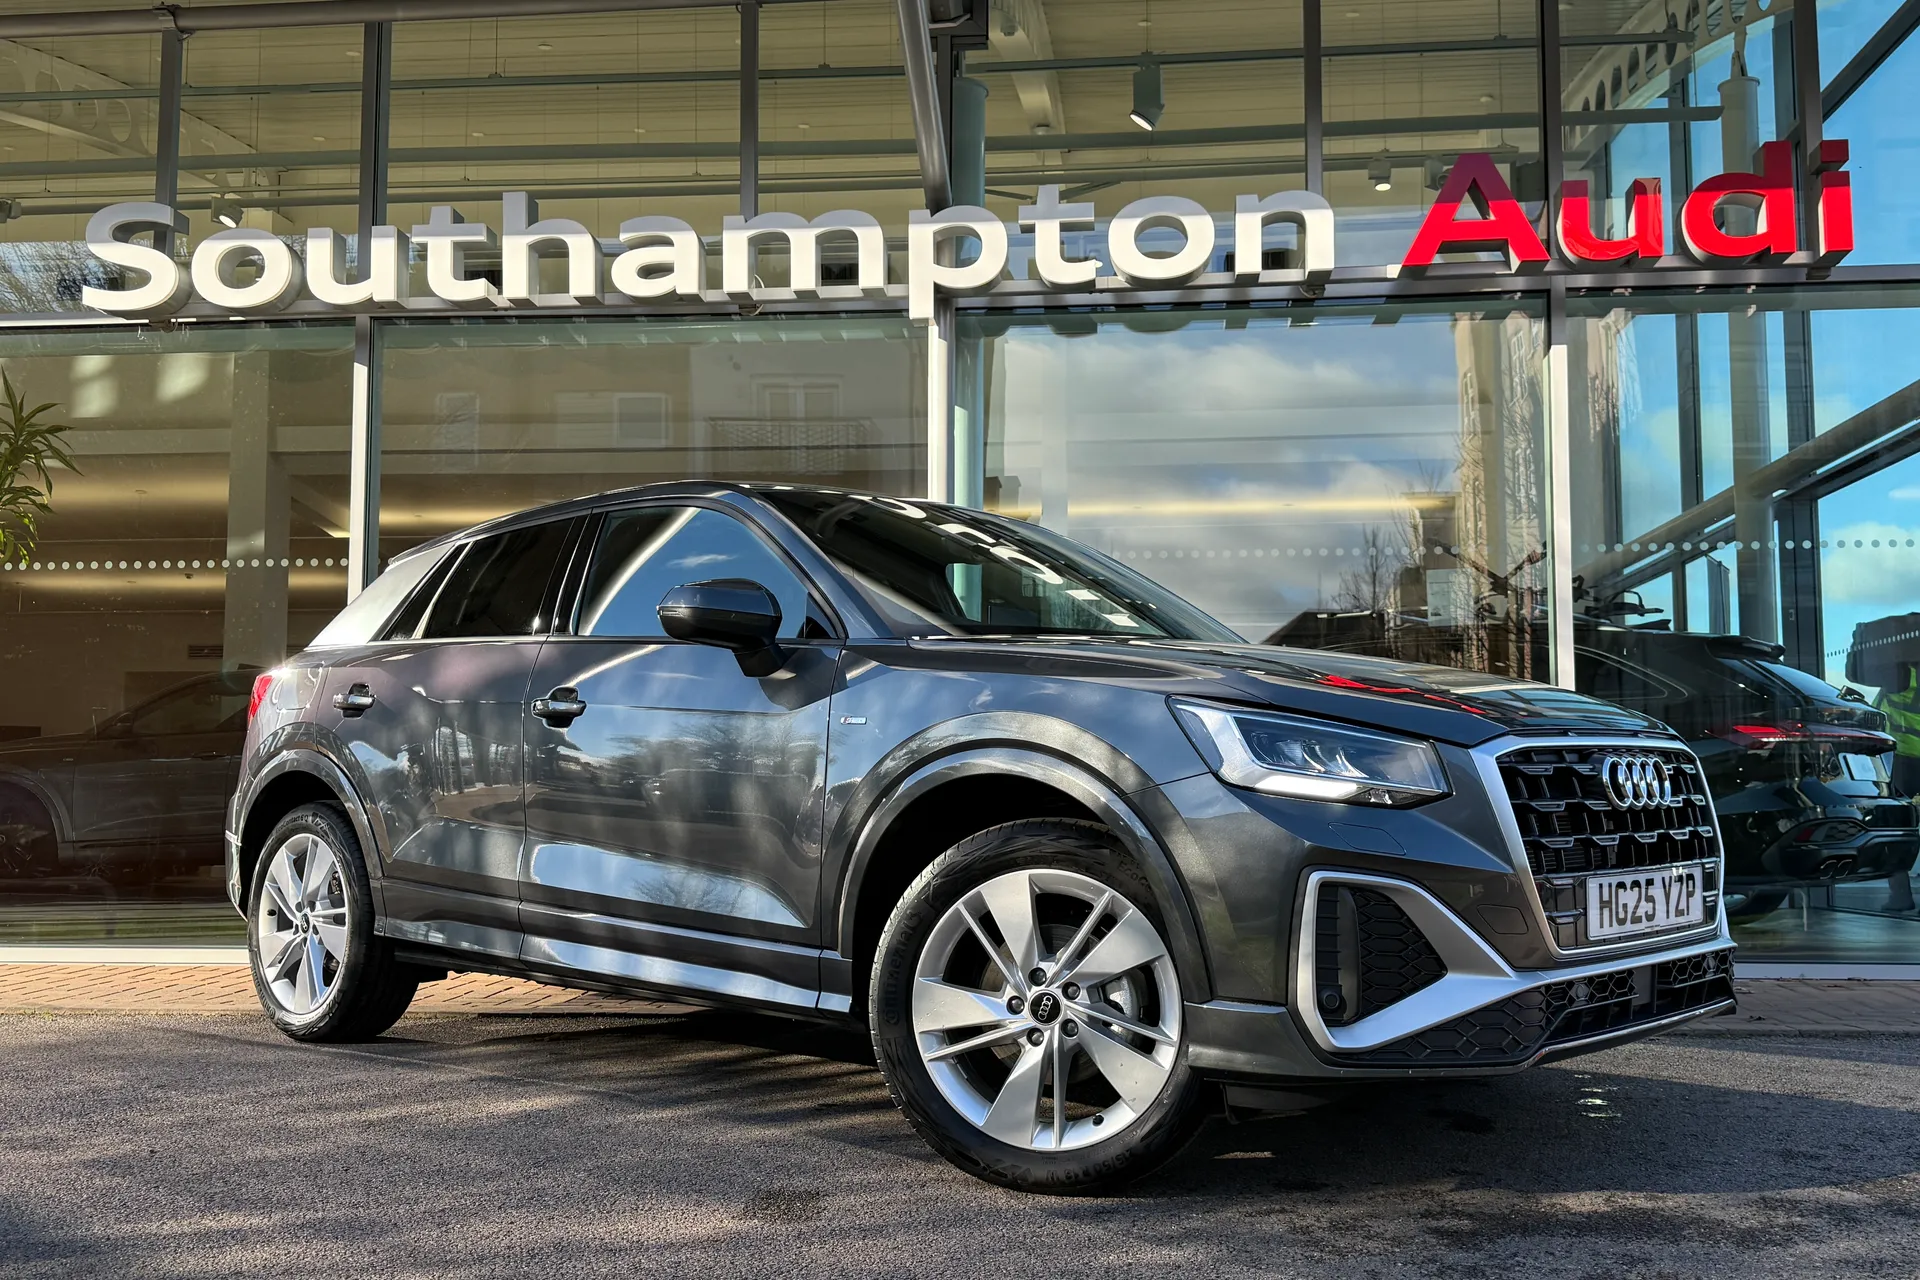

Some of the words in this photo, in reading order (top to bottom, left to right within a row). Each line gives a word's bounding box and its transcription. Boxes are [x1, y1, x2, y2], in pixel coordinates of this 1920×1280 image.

[81, 190, 1334, 321] Southampton
[1400, 139, 1854, 270] Audi
[1599, 878, 1656, 929] HG25
[1662, 872, 1696, 920] YZP
